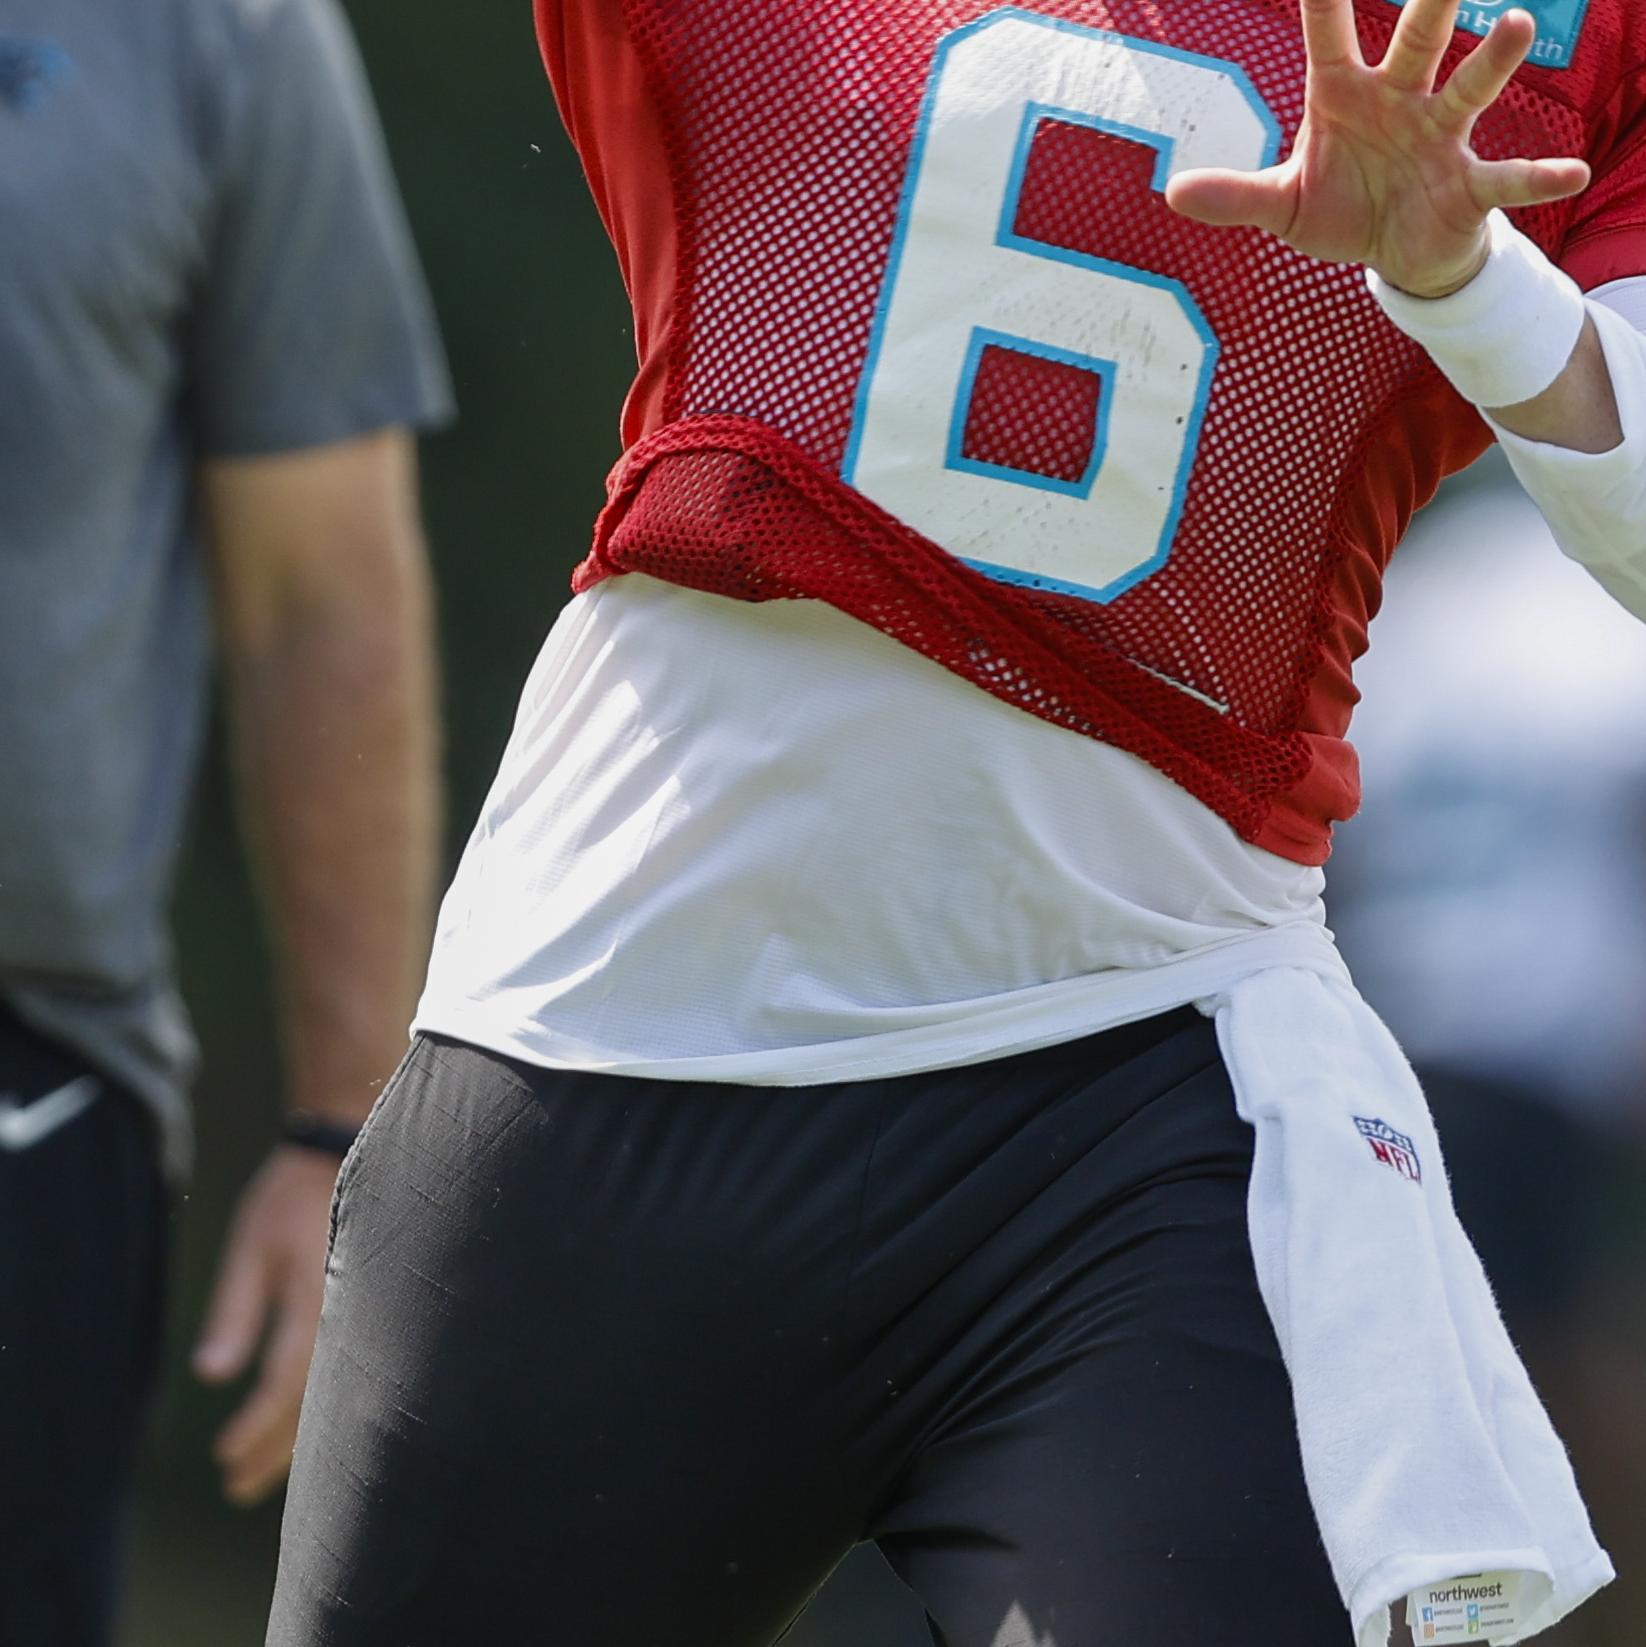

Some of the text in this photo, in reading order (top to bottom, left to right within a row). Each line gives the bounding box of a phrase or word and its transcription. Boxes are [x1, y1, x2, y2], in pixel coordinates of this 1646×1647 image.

[840, 6, 1282, 605] 6
[1366, 1136, 1419, 1182] NFL
[1429, 1581, 1503, 1603] northwest
